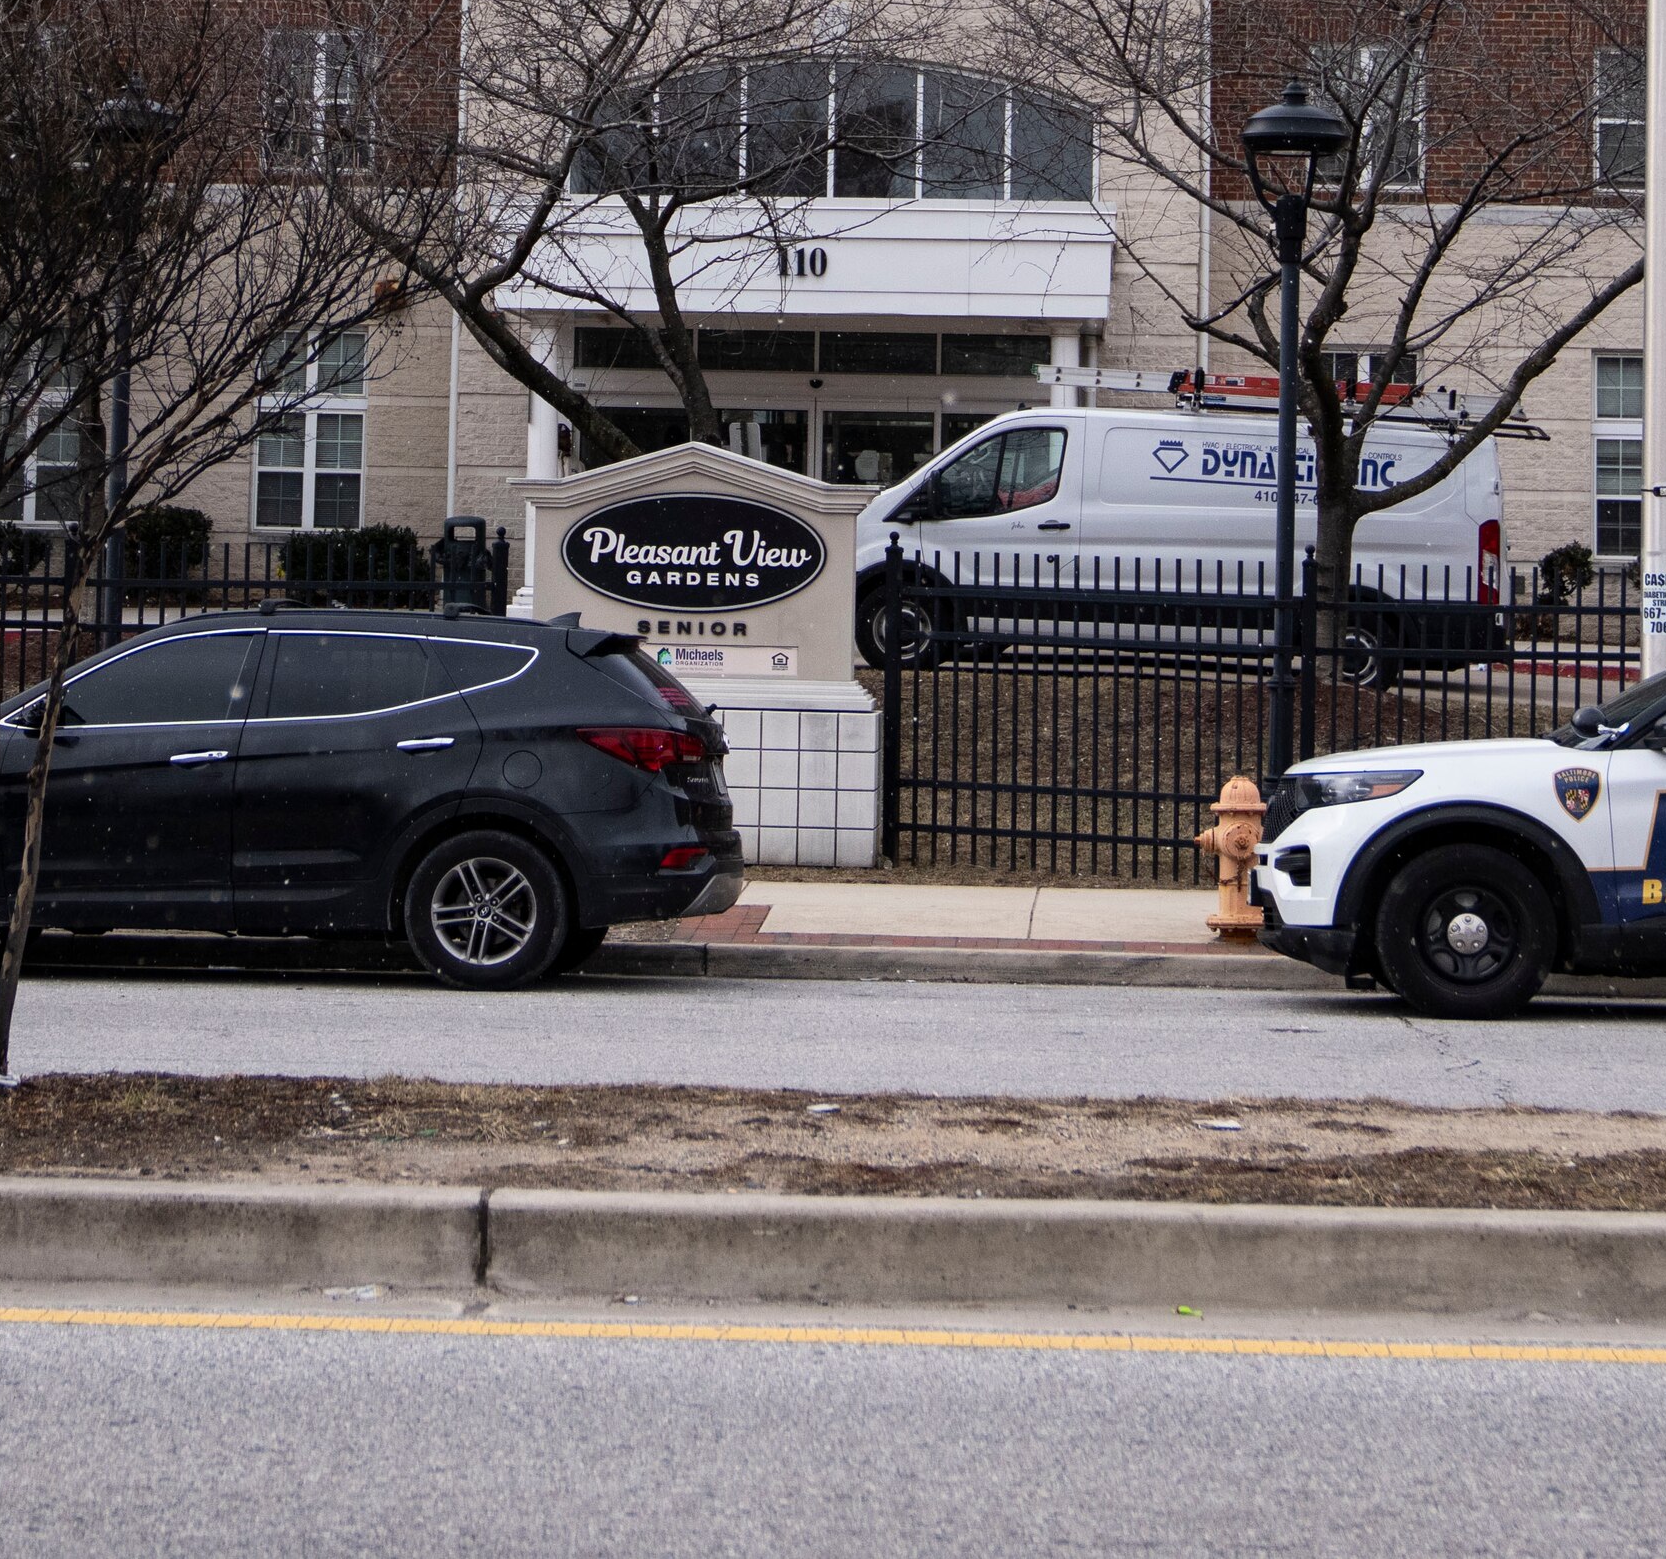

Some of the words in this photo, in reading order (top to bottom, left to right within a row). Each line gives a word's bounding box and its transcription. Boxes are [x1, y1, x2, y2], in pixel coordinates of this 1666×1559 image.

[777, 247, 828, 277] 110
[1202, 441, 1220, 449] HVAC
[1225, 443, 1263, 451] ELECTRICAL
[1367, 452, 1403, 461] CONTROLS
[583, 527, 721, 566] Pleasant
[723, 530, 812, 568] View
[626, 570, 760, 587] GARDENS
[637, 620, 747, 637] SENIOR
[675, 648, 724, 661] Michaels
[1556, 769, 1597, 780] BALTIMORE
[1564, 775, 1589, 784] POLICE
